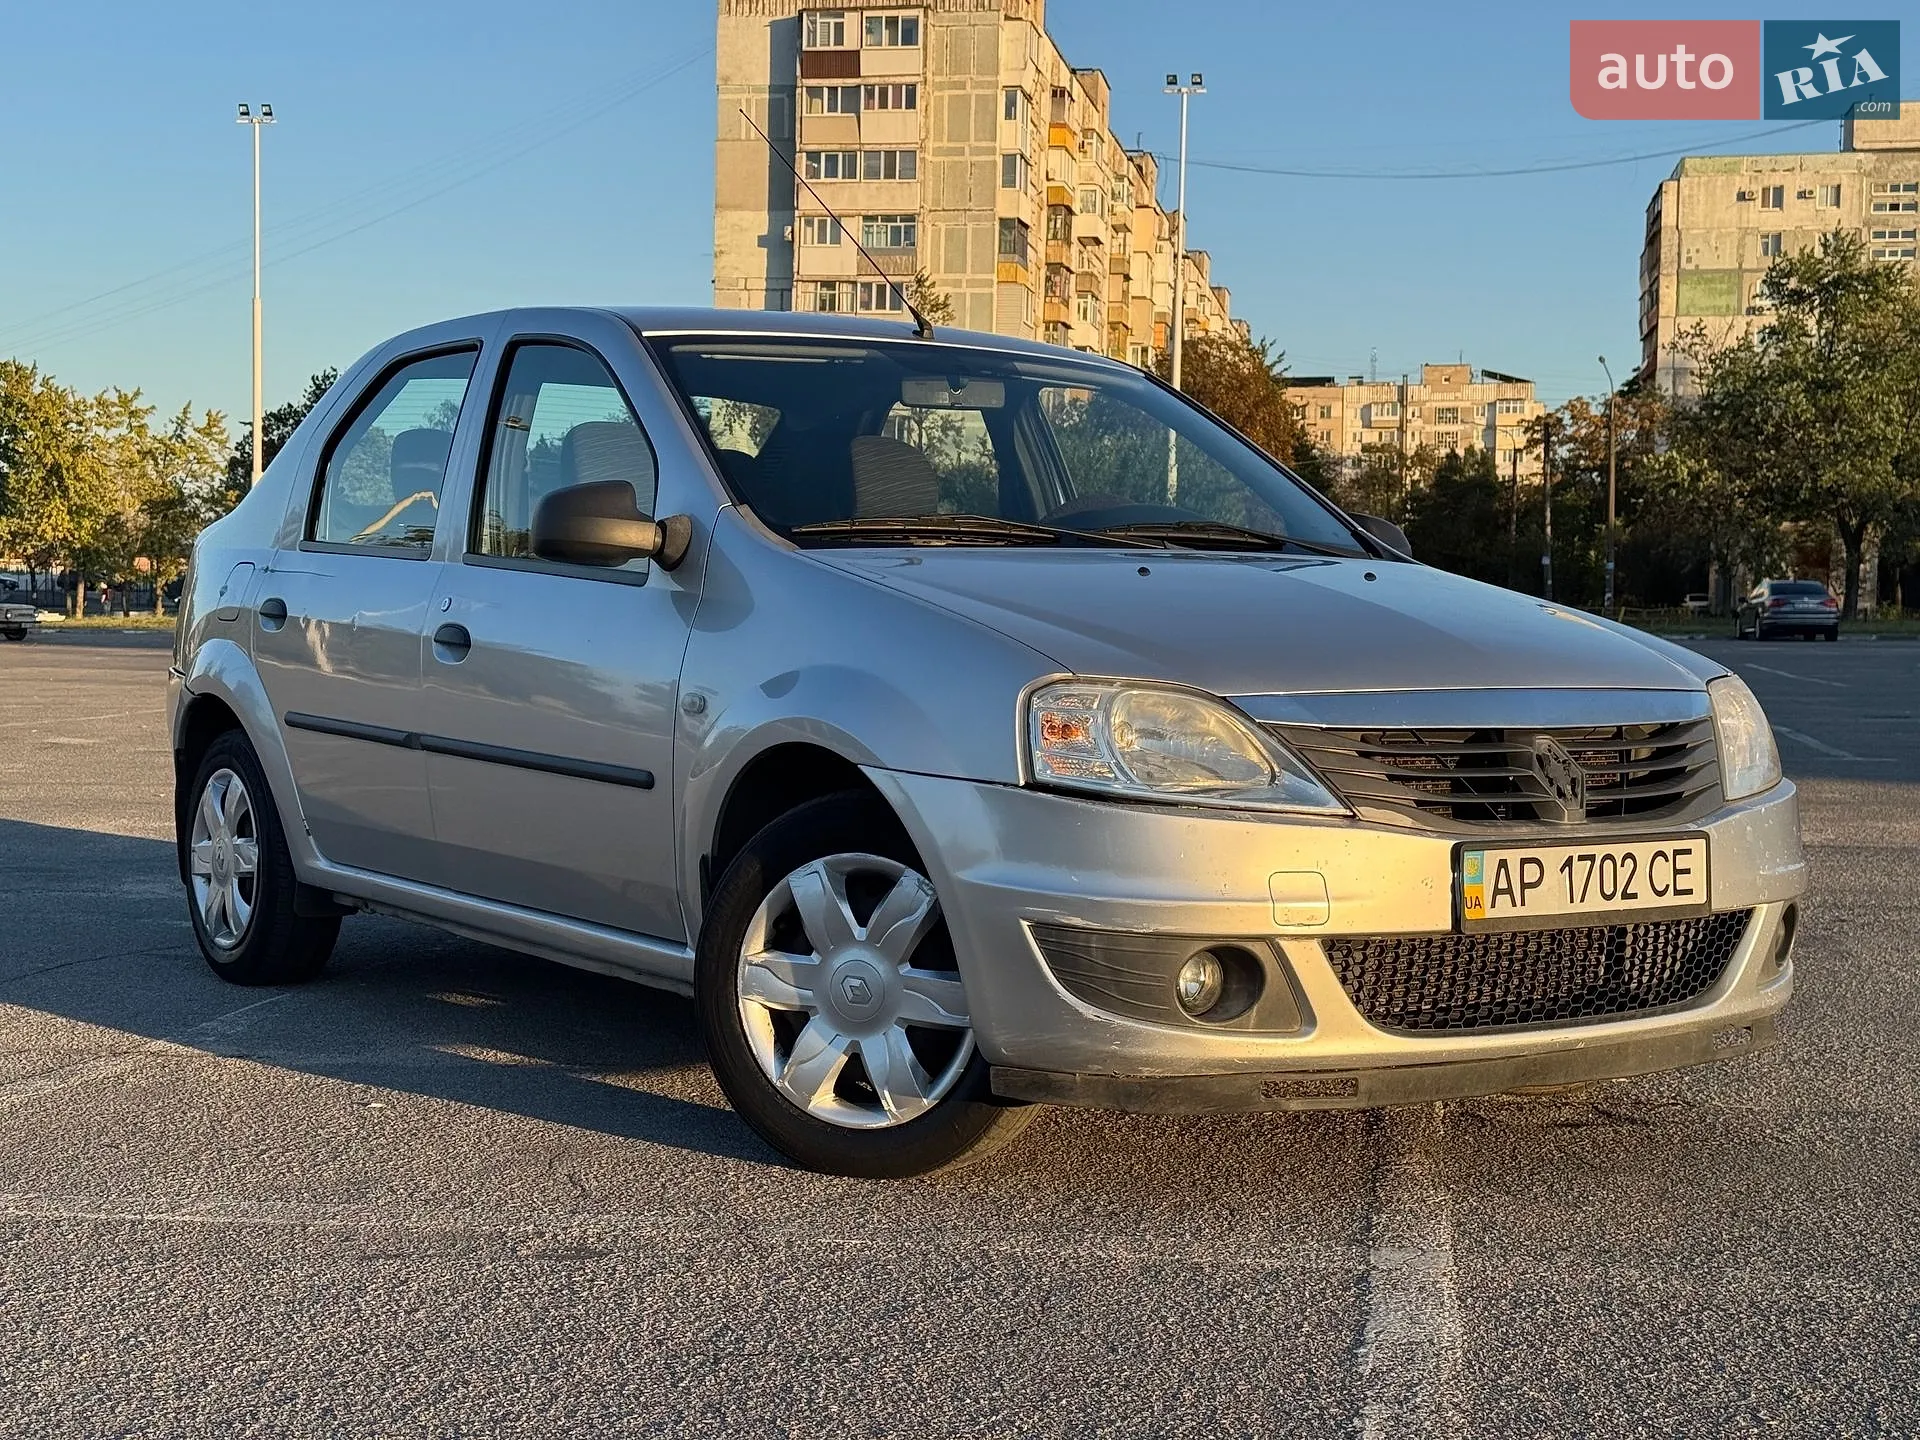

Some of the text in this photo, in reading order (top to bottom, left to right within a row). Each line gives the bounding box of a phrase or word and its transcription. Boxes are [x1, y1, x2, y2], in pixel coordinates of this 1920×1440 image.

[1490, 848, 1694, 909] AP 1702 CE
[1464, 896, 1482, 910] UA
